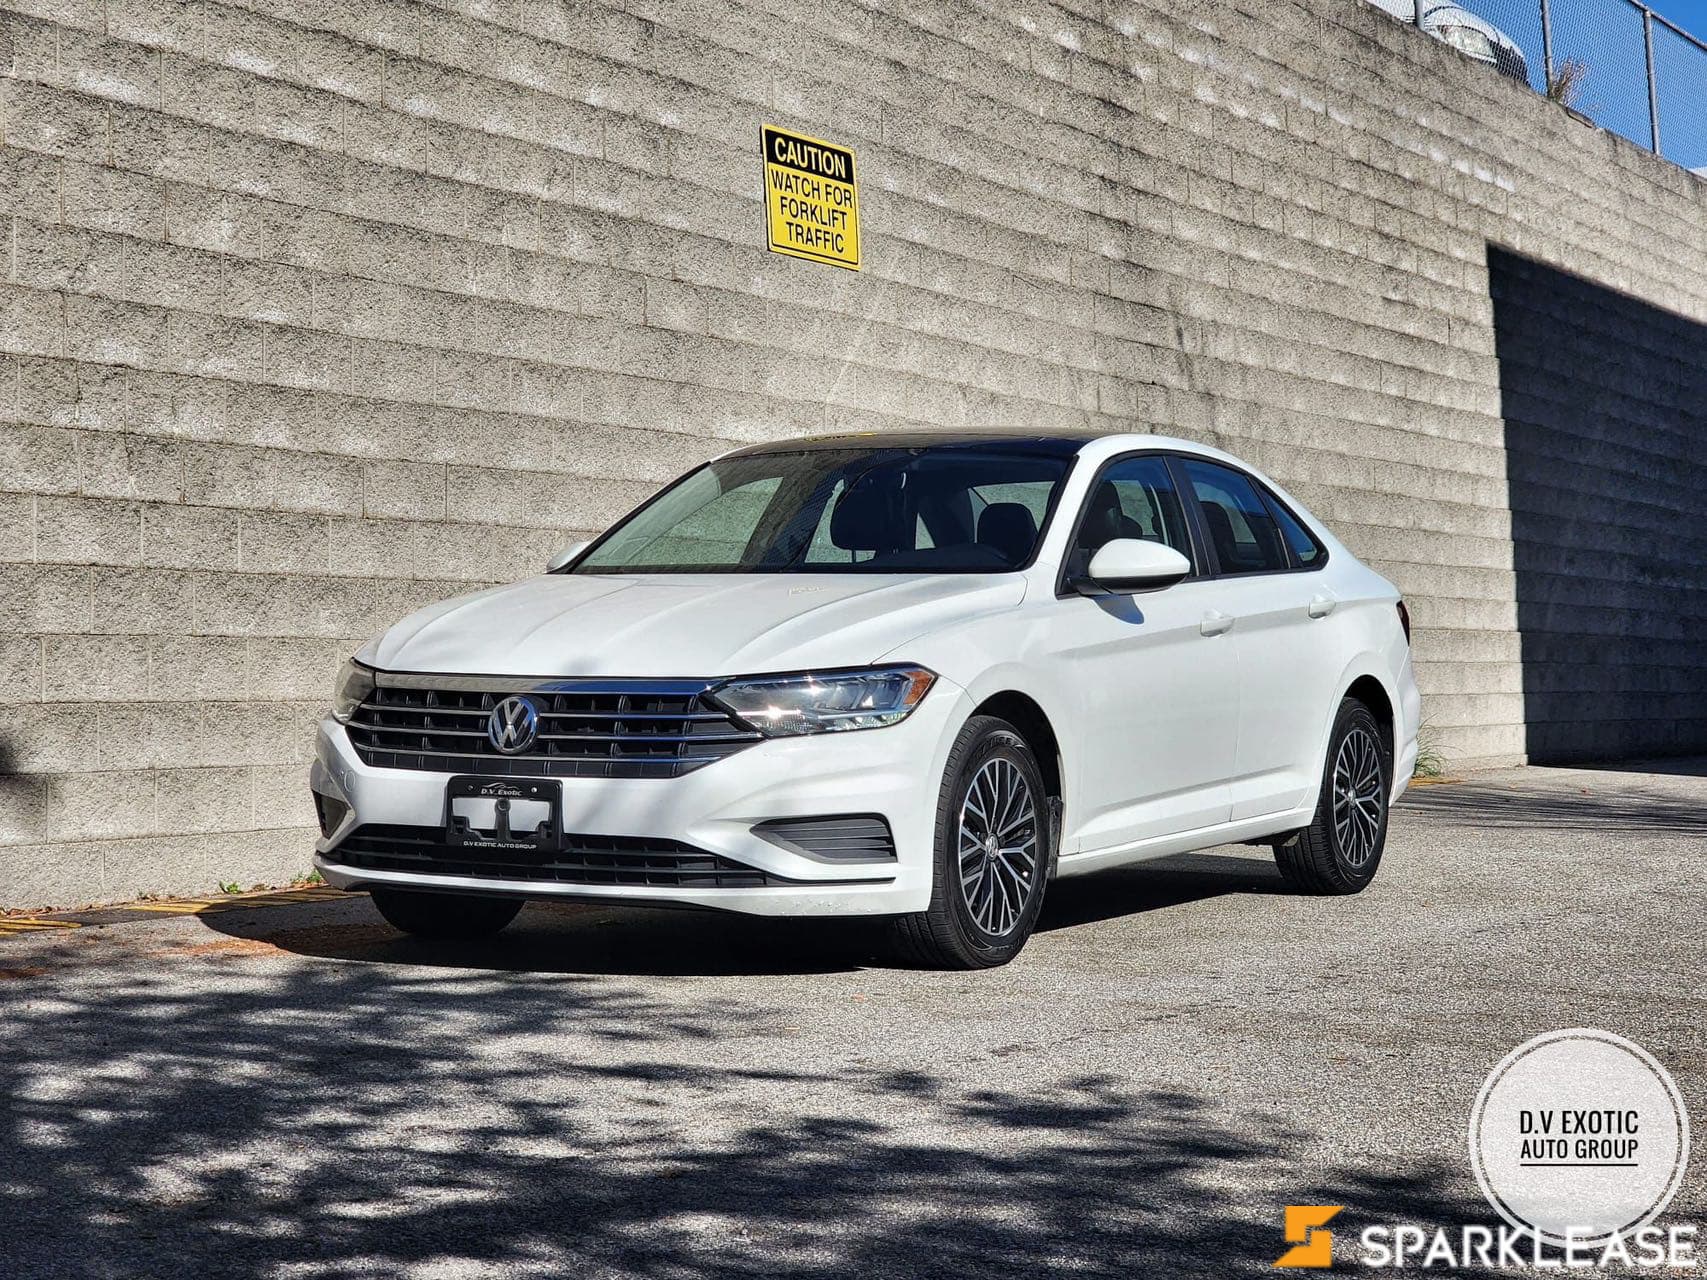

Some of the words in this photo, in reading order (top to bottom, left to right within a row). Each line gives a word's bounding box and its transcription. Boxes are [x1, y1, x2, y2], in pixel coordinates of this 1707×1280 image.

[774, 137, 846, 178] CAUTION
[770, 169, 821, 200] WATCH
[825, 184, 853, 208] FOR
[780, 196, 847, 230] FORKLIFT
[785, 221, 844, 253] TRAFFIC
